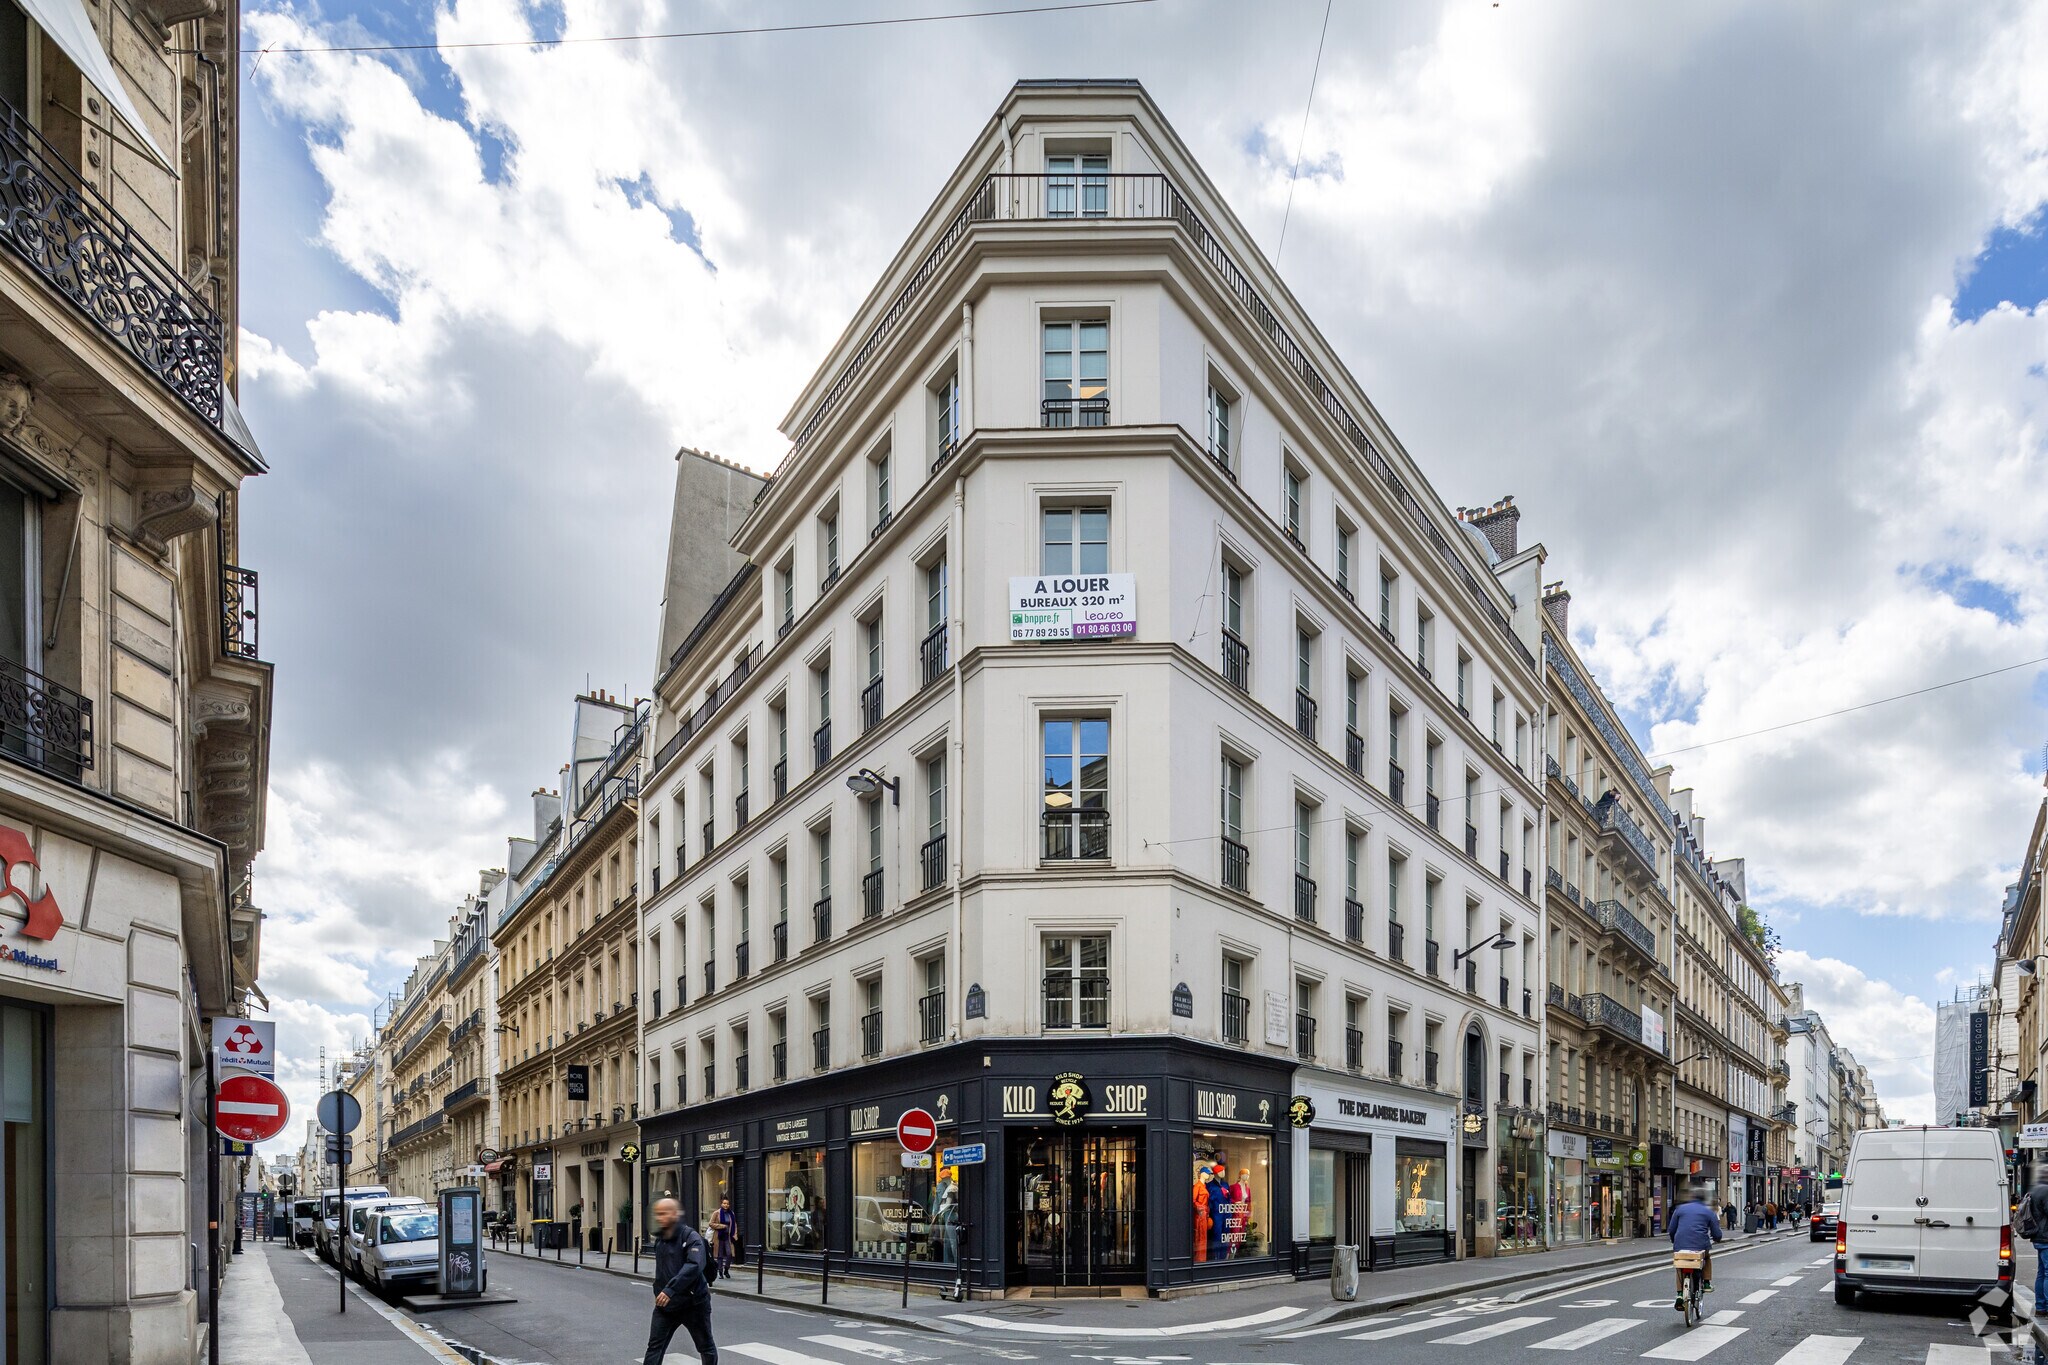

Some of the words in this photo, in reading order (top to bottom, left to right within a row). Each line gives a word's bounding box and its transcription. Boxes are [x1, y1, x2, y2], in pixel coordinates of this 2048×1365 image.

[1034, 580, 1048, 594] A
[1054, 577, 1110, 593] LOUER
[1020, 597, 1078, 608] BUREAUX
[1082, 595, 1105, 606] 320
[1024, 612, 1060, 625] bnppre.fr
[1012, 629, 1023, 638] 06
[1025, 629, 1034, 637] 77
[1036, 628, 1046, 637] 89
[1047, 628, 1058, 637] 29
[1060, 627, 1070, 637] 55
[1076, 625, 1086, 634] 01
[1088, 624, 1098, 634] 80
[1100, 624, 1109, 633] 96
[1111, 623, 1121, 632] 03
[12, 949, 58, 970] Mutuel
[1974, 1017, 1983, 1052] GERARD
[246, 1058, 271, 1066] Mutuel
[1055, 1072, 1068, 1080] KILO
[1068, 1072, 1084, 1080] SHOP
[1974, 1056, 1983, 1102] CATHERINE
[1003, 1085, 1036, 1113] KILO
[1105, 1084, 1148, 1112] SHOP.
[1198, 1089, 1214, 1117] KILO
[1338, 1098, 1356, 1116] THE
[1356, 1101, 1399, 1122] DELAMBRE
[1399, 1108, 1428, 1126] BAKERY
[776, 1120, 792, 1131] WORLD'S
[792, 1118, 808, 1129] LARGEST
[850, 1108, 863, 1132] KILO
[1055, 1117, 1071, 1126] SINCE
[776, 1132, 790, 1142] VINTAGE
[790, 1130, 809, 1141] SELECTION
[882, 1208, 902, 1219] WORLD'S
[902, 1208, 924, 1219] LAGEST
[1221, 1232, 1247, 1244] EMPORTEZ
